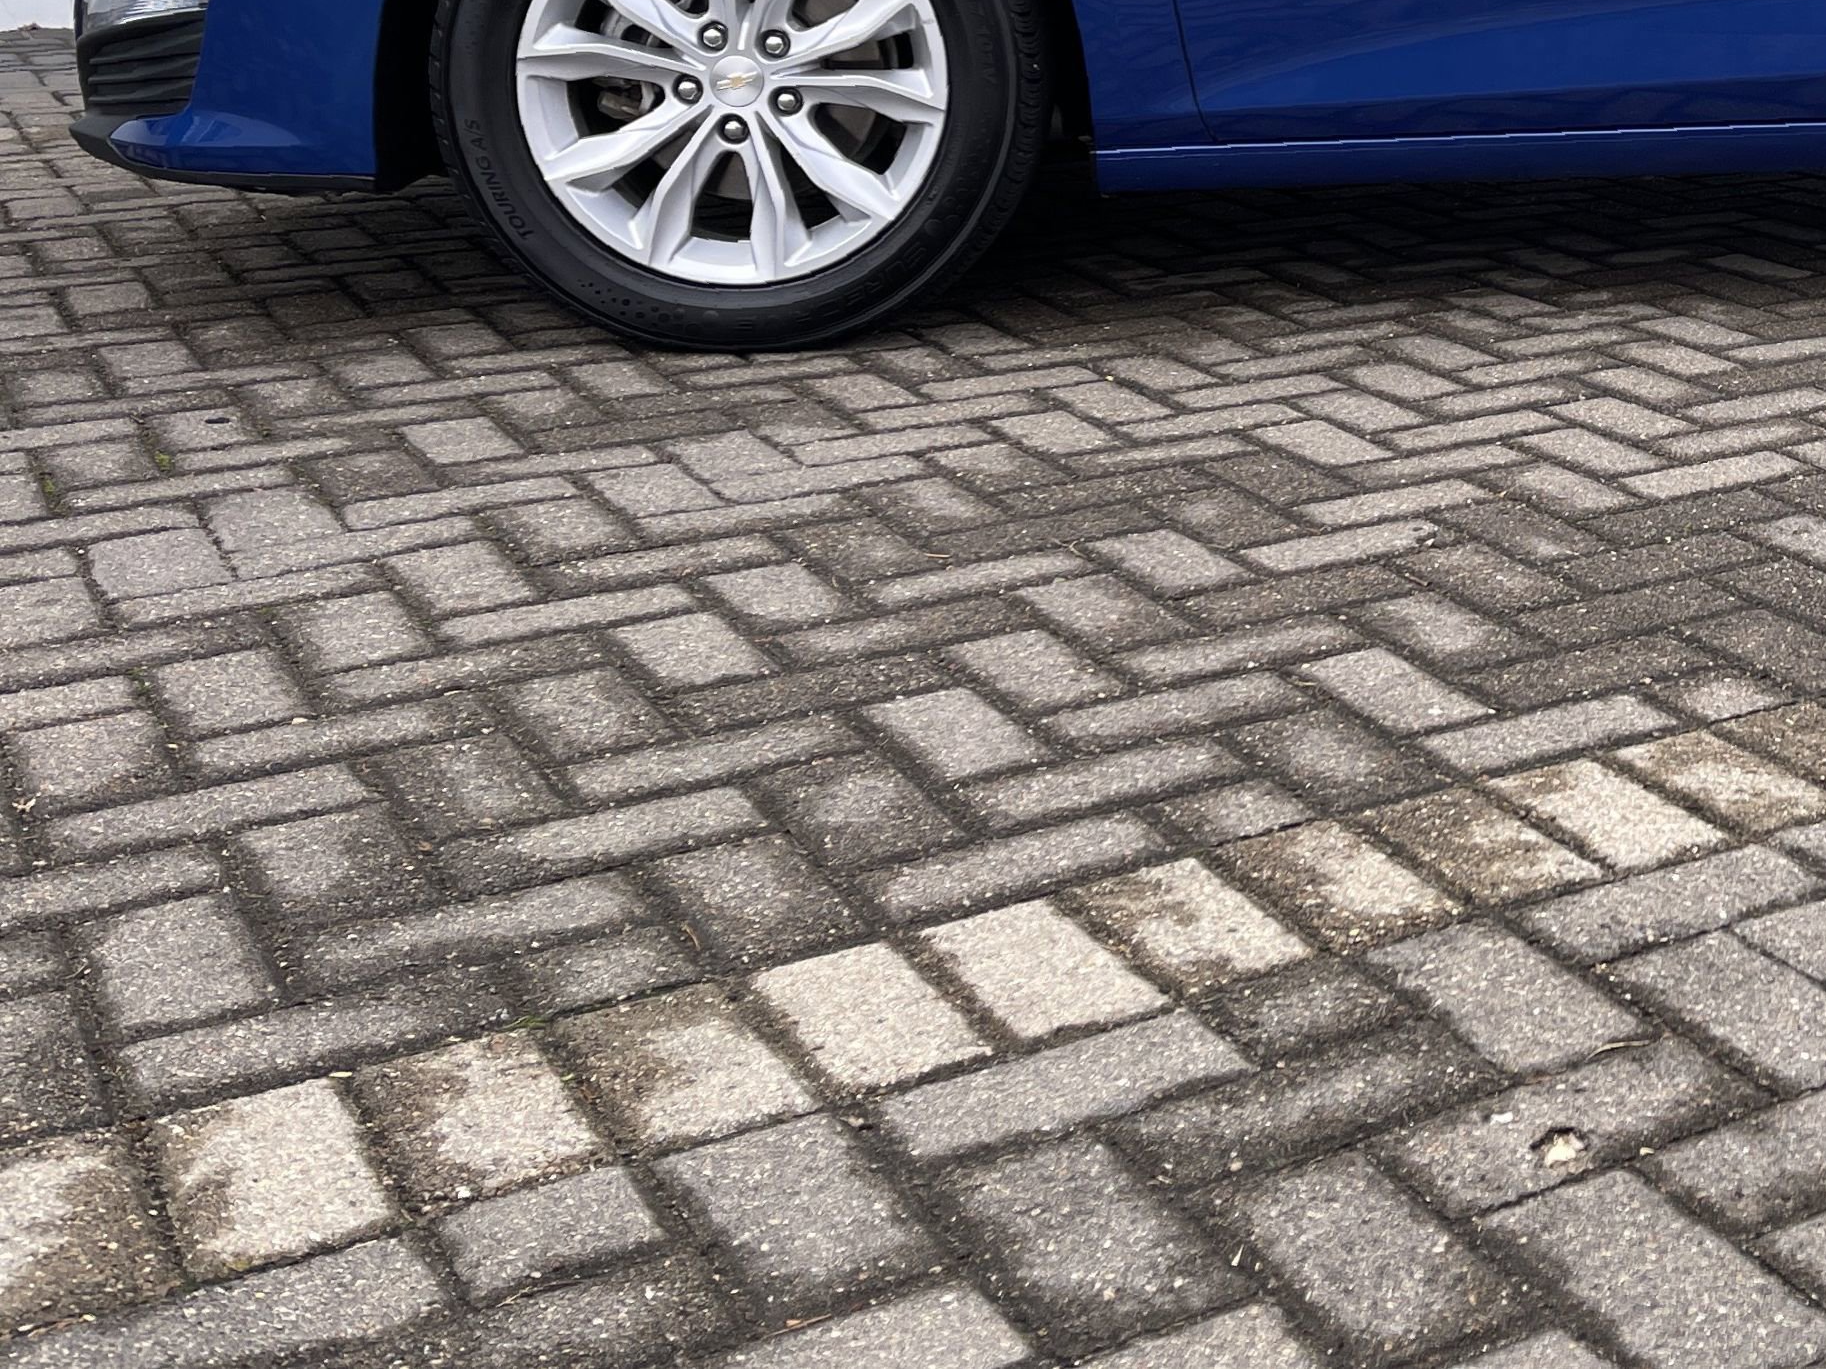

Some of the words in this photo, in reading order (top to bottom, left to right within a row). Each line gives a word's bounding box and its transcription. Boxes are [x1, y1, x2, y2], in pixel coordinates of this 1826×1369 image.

[463, 118, 488, 150] A/S
[475, 156, 535, 240] TOURING
[735, 240, 928, 331] SUREDRE
